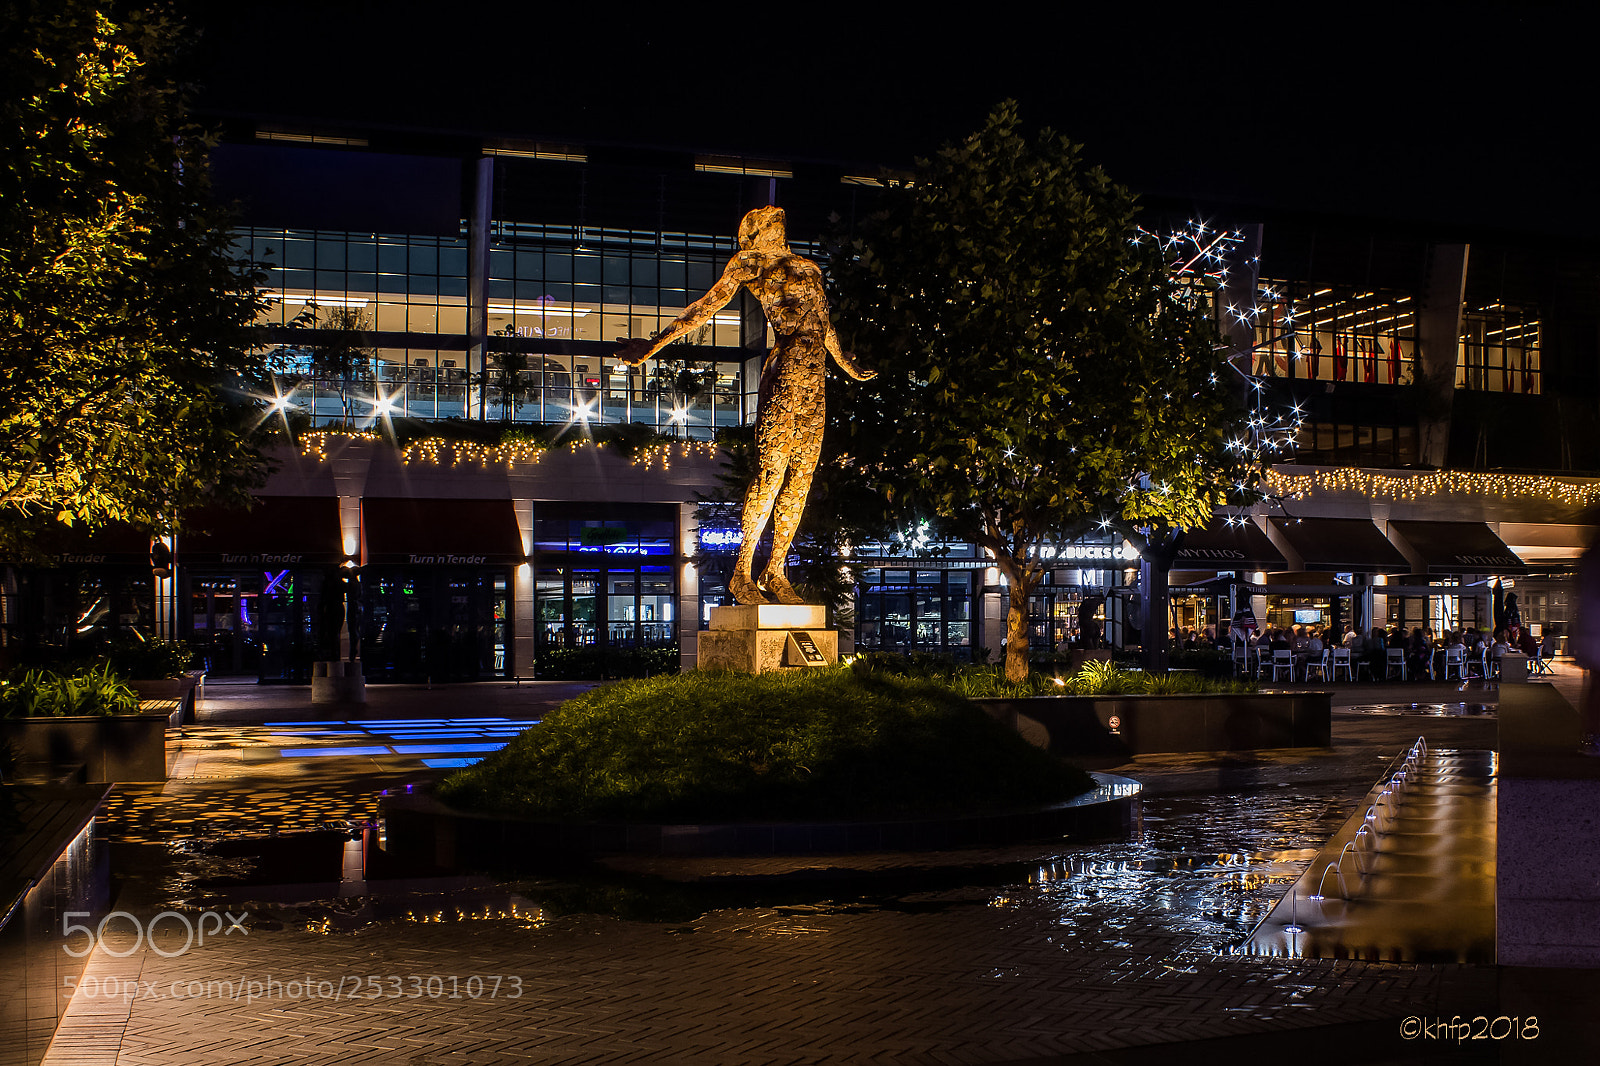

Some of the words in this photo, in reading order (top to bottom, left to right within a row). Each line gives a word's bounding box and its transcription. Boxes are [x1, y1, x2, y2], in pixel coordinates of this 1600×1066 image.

[62, 552, 107, 563] Tender
[220, 553, 248, 563] Turn
[260, 553, 303, 563] Tender
[1177, 548, 1246, 559] MYTHOS
[408, 554, 435, 564] Turn
[446, 554, 487, 564] Tender
[1455, 555, 1518, 565] MYTHOS
